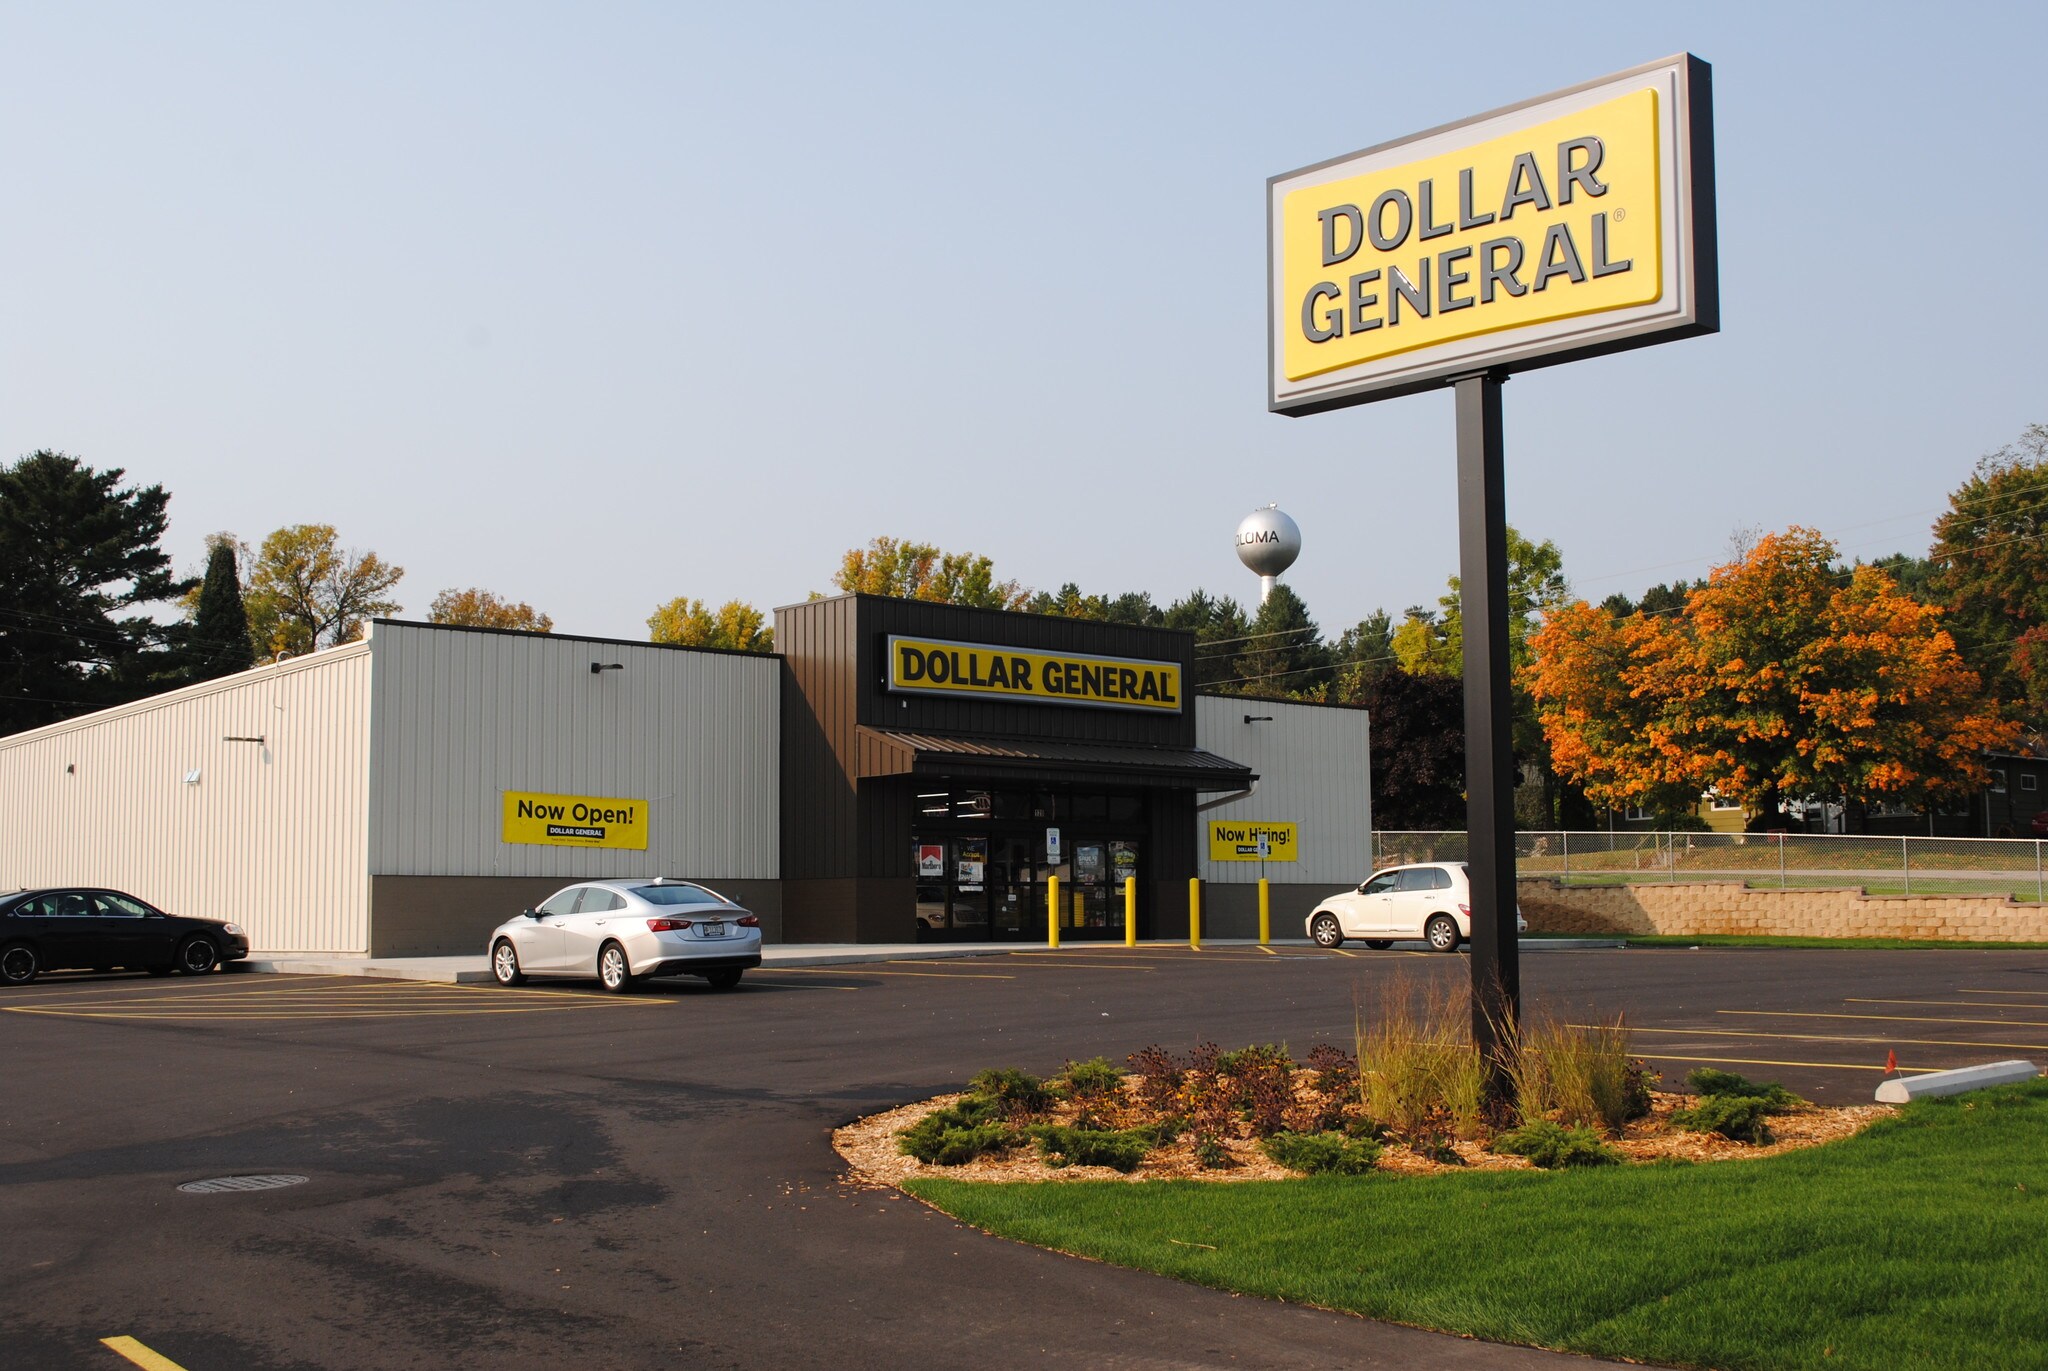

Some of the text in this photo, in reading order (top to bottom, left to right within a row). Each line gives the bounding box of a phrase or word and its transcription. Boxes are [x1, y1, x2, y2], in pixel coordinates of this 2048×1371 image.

[1318, 135, 1609, 267] DOLLAR
[1301, 212, 1633, 343] GENERAL
[900, 647, 1175, 702] DOLLAR GENERAL
[518, 800, 634, 825] Now Open!
[550, 827, 602, 836] DOLLAR GENERAL
[1216, 827, 1290, 845] Now Hiing!
[922, 862, 941, 870] Marlboro
